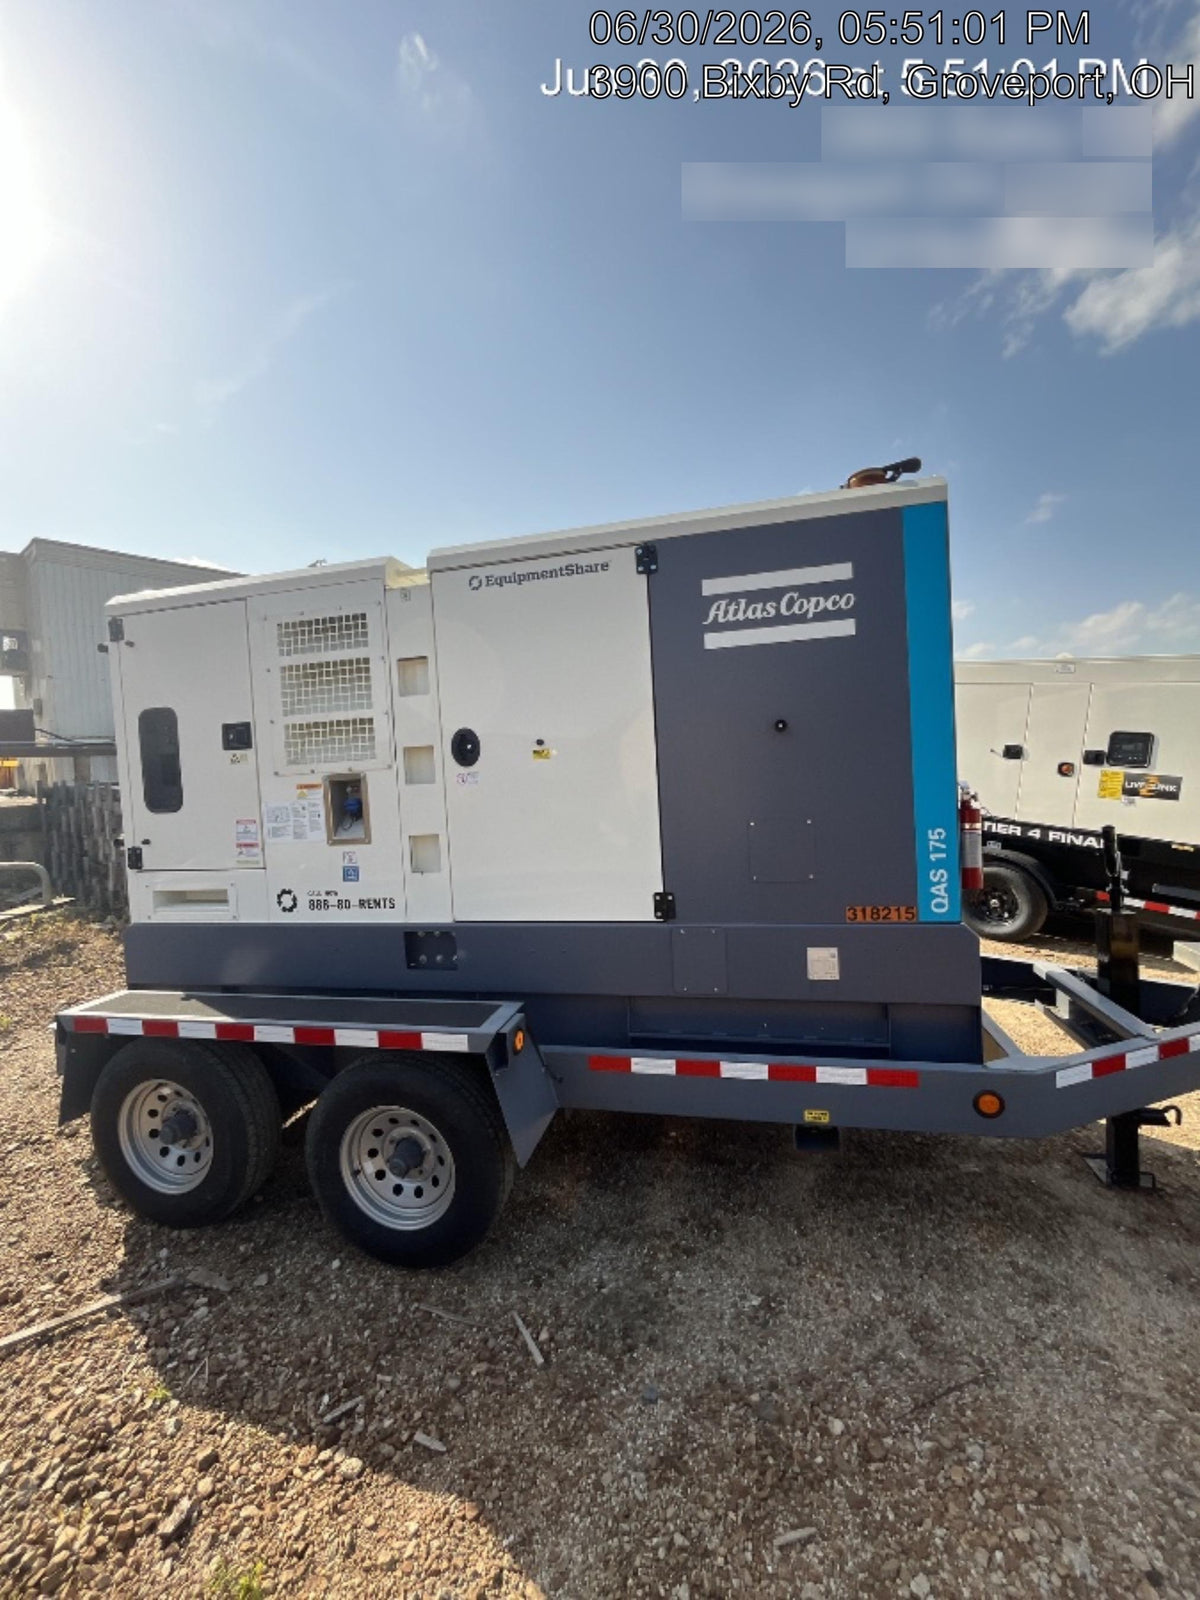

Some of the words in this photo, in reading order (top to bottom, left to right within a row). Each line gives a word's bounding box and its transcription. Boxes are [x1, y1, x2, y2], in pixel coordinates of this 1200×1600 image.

[484, 561, 609, 588] EquipmentShare
[702, 599, 776, 625] Atlas
[779, 592, 856, 619] Copco
[927, 827, 947, 862] 175
[983, 821, 1022, 836] TIER
[1027, 828, 1041, 840] 4
[929, 868, 949, 914] QAS
[847, 906, 916, 921] 318215
